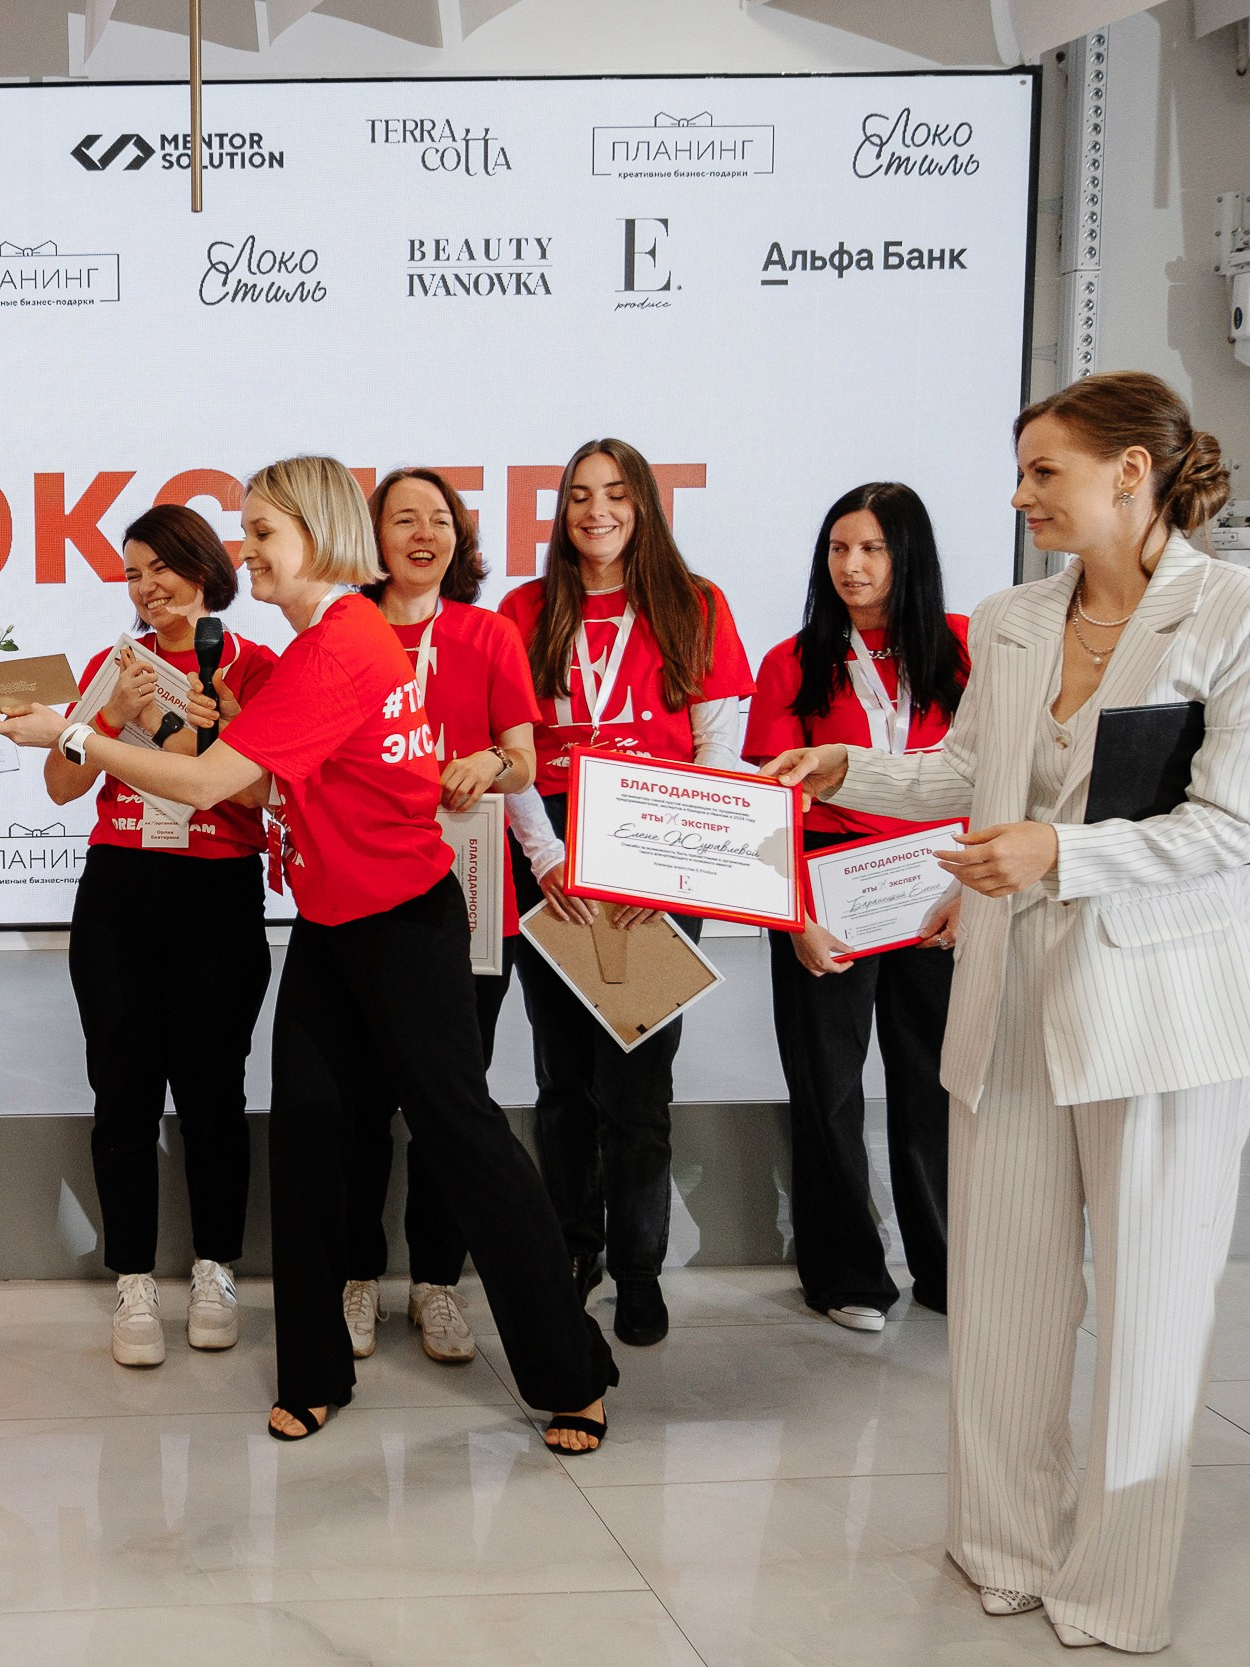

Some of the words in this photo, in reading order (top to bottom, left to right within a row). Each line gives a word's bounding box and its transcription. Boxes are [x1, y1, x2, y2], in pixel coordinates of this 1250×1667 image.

[160, 130, 263, 152] MENTOR
[367, 119, 457, 143] TERRA
[612, 140, 753, 161] ПЛАНИНГ
[408, 237, 552, 262] BEAUTY
[615, 218, 682, 292] E.
[762, 242, 874, 278] Альфа
[883, 241, 967, 270] Банк
[407, 272, 552, 297] IVANOVKA
[614, 297, 671, 311] produce
[381, 723, 434, 764] ЭКС
[620, 778, 751, 808] БЛАГОДАРНОСТЬ
[641, 813, 664, 823] #ТЫ
[681, 819, 730, 833] ЭКСПЕРТ
[613, 823, 660, 840] Елене
[663, 830, 761, 858] Журавлевой
[844, 847, 933, 875] БЛАГОДАРНОСТЬ
[29, 876, 80, 885] бизнес-под
[468, 838, 478, 932] БЛАГОДАРНОСТЬ
[862, 886, 878, 894] #ТЫ
[888, 875, 922, 888] ЭКСПЕРТ
